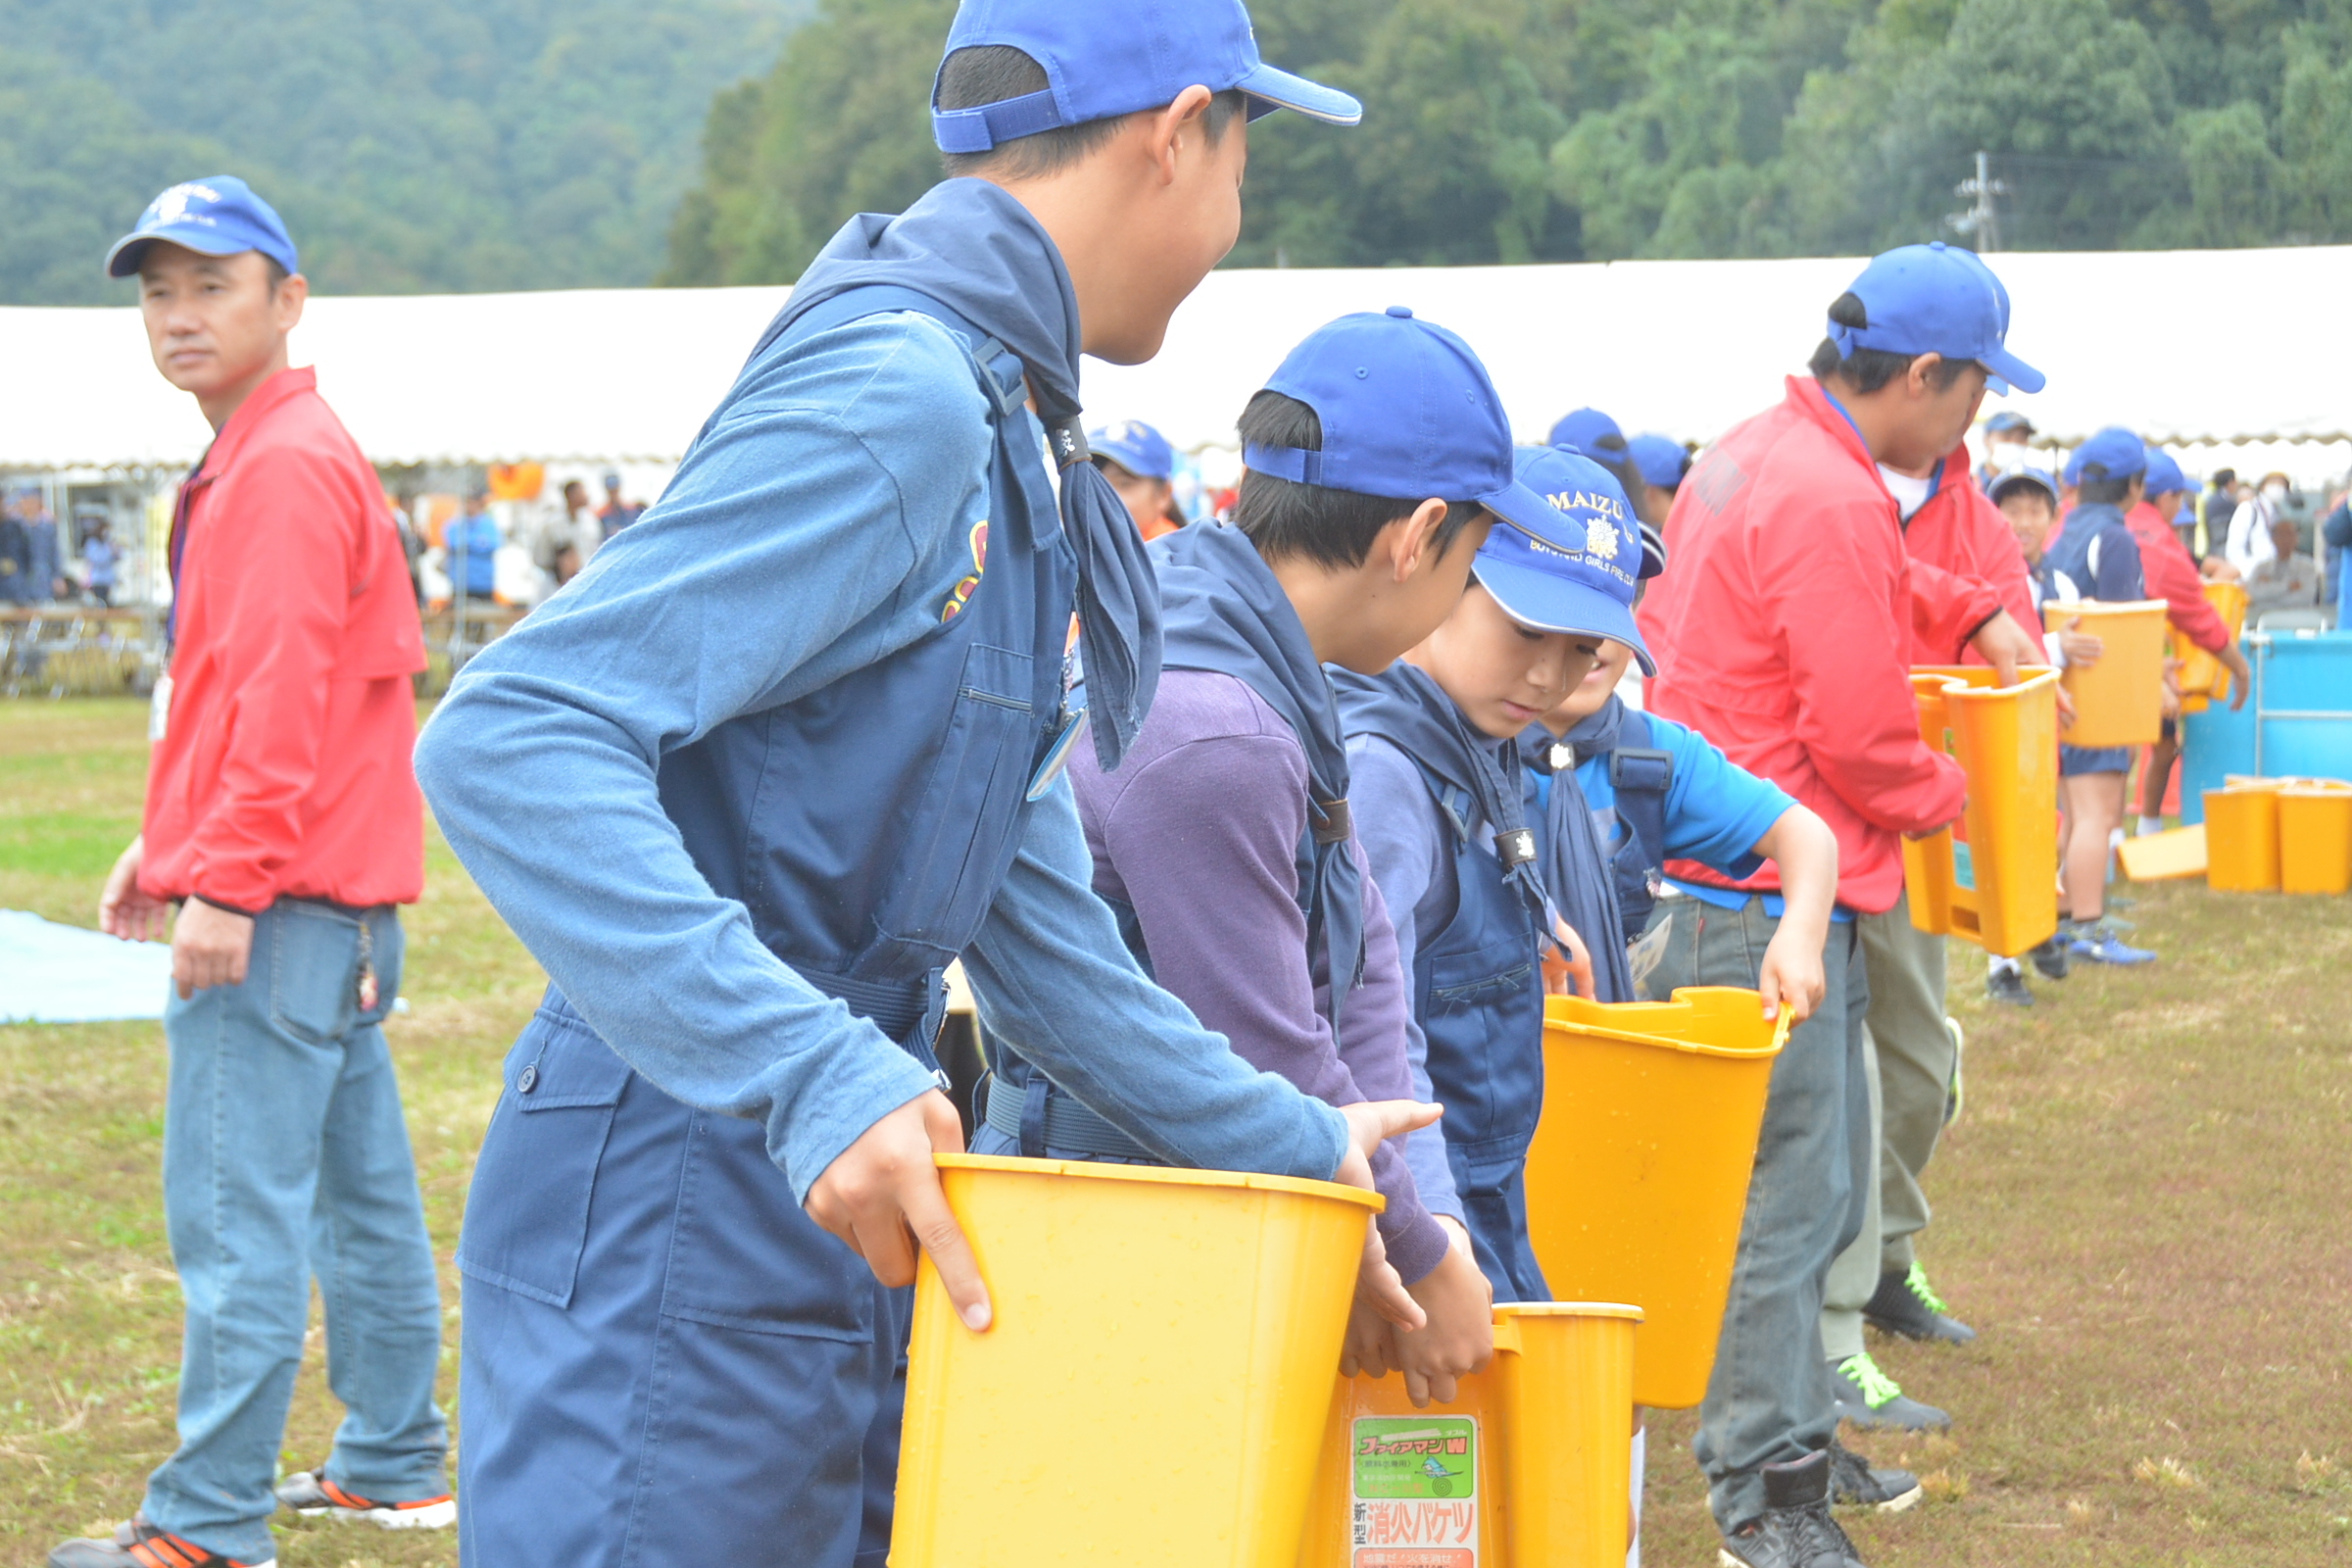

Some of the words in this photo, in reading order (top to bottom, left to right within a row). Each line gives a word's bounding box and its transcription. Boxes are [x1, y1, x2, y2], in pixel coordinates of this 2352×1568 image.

[1585, 555, 1610, 572] GIRLS
[1353, 1502, 1366, 1544] 新型
[1367, 1502, 1473, 1544] 消火バケツ
